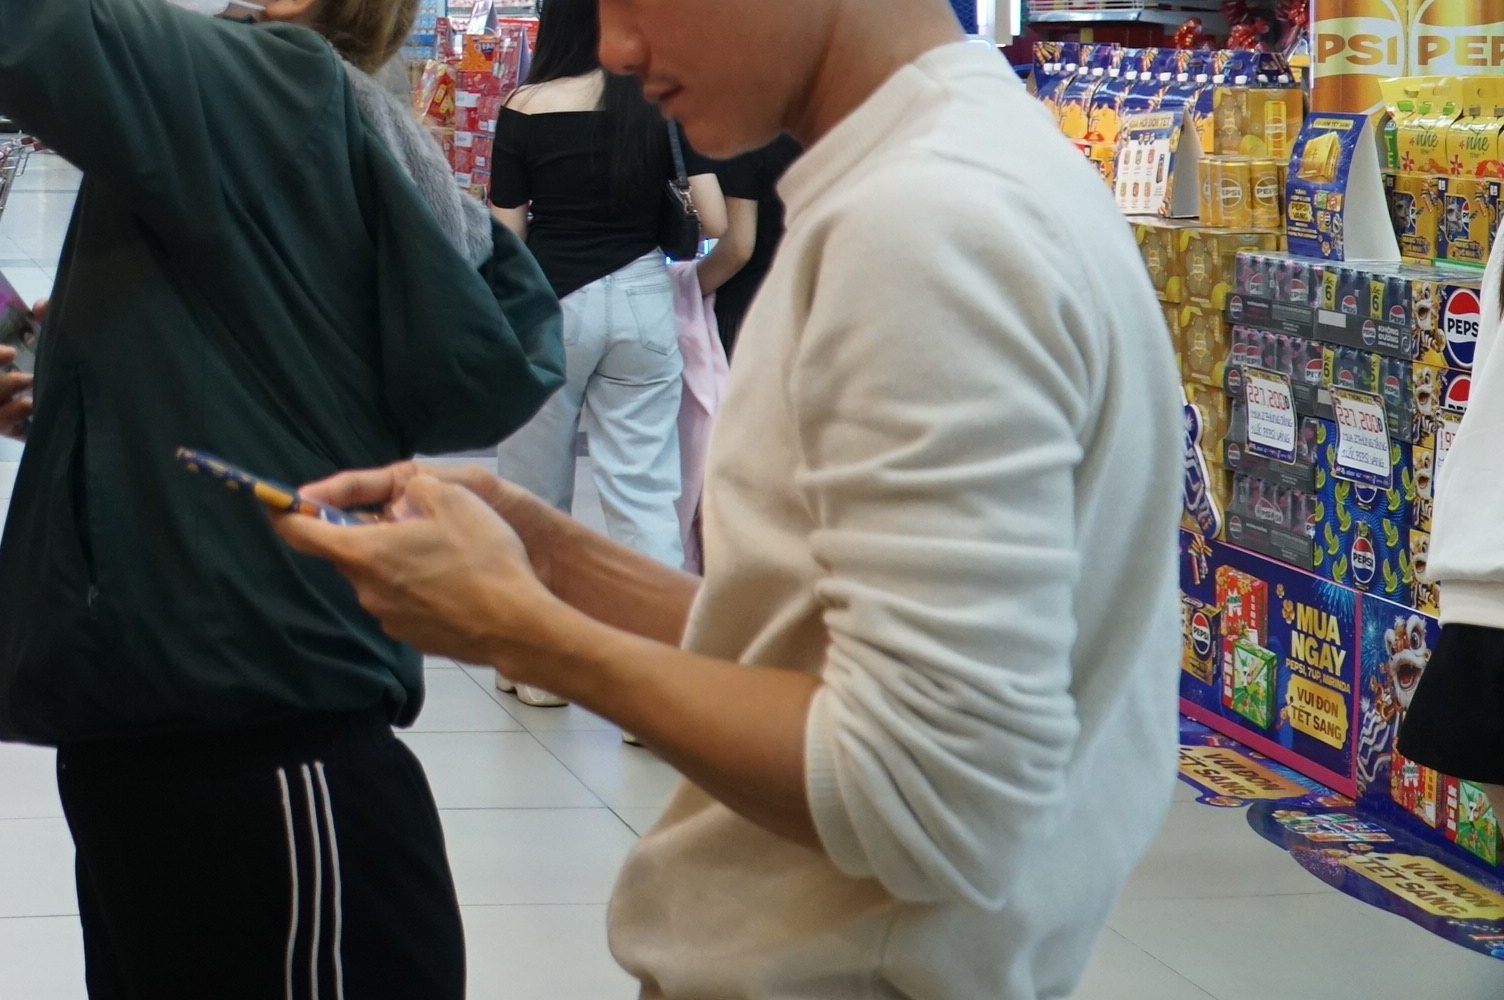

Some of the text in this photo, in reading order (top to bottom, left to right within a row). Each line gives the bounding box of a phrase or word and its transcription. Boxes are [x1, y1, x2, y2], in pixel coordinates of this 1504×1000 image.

[1314, 33, 1398, 66] PSI
[1371, 295, 1380, 310] 6
[1447, 317, 1479, 337] PEPS
[1353, 551, 1374, 568] PEPSI
[1296, 602, 1342, 646] MUA
[1290, 629, 1347, 677] NGAY
[1296, 686, 1340, 719] VUI ĐÓN
[1291, 703, 1343, 742] TẾT SANG
[1193, 766, 1256, 797] SANG
[1354, 855, 1470, 916] TẾT SANG
[1400, 861, 1446, 884] VUI
